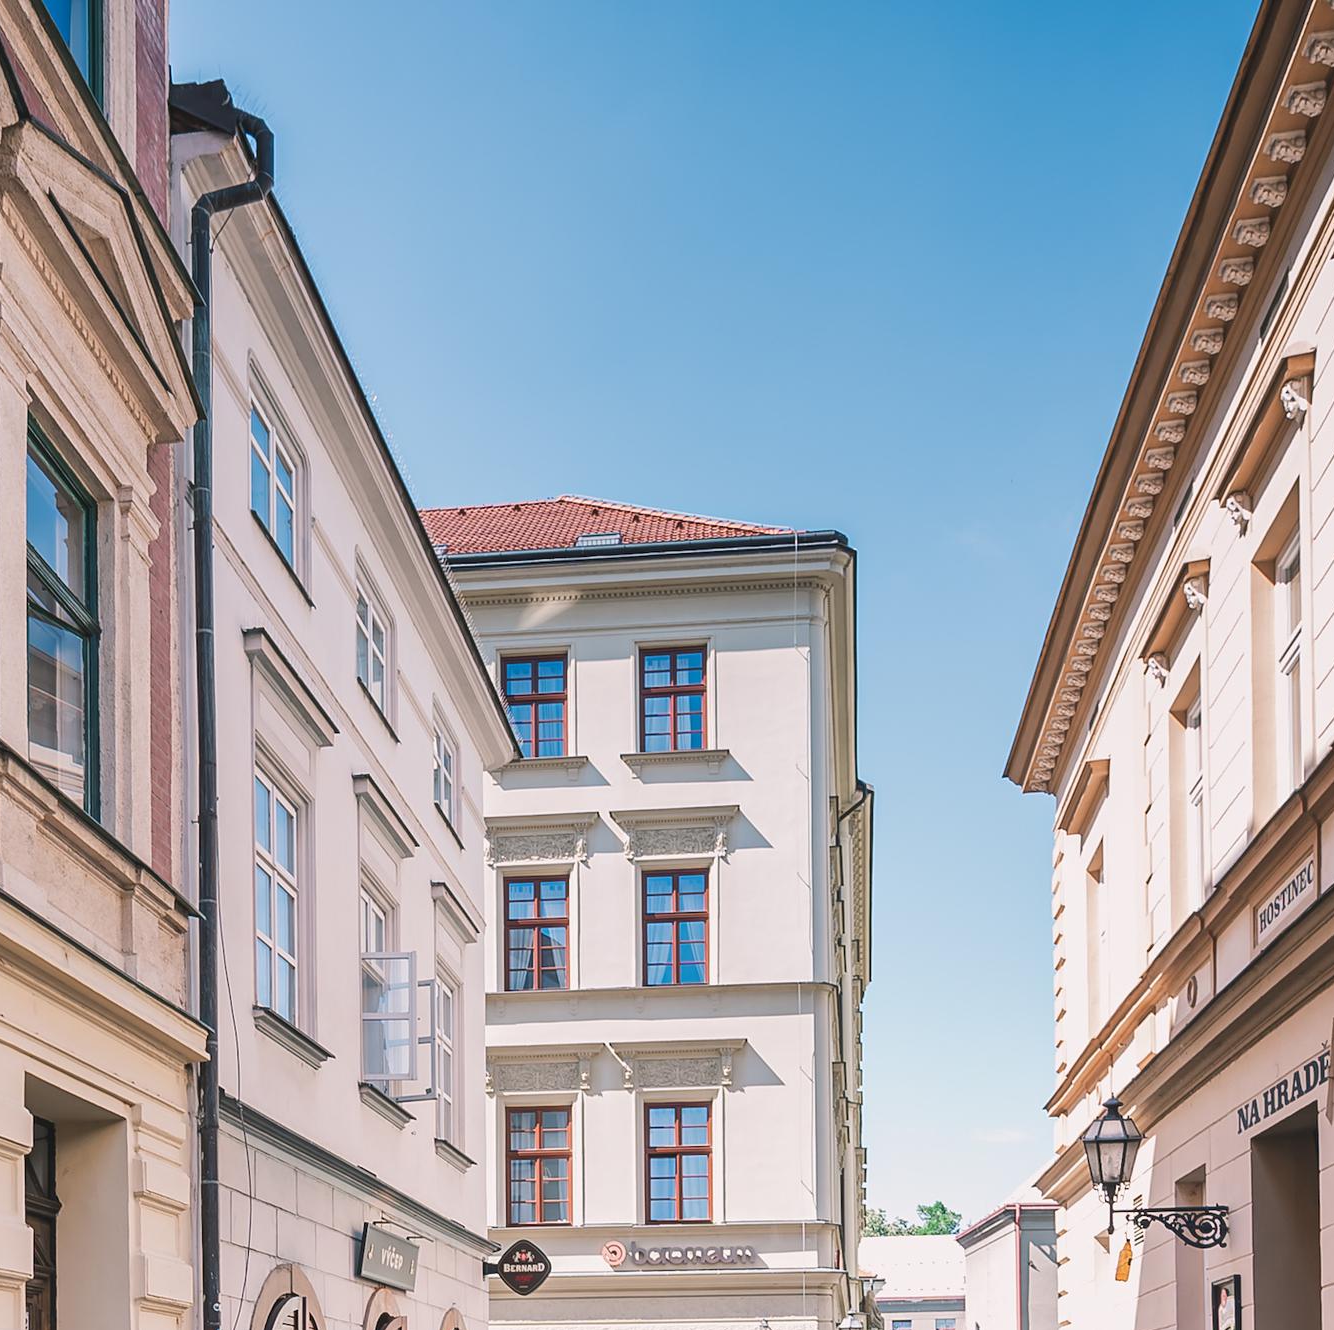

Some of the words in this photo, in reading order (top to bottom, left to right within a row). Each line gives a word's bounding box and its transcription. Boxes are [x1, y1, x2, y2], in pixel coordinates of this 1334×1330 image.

[1259, 860, 1314, 934] HOSTINEC
[1237, 1099, 1261, 1135] NA
[381, 1242, 404, 1273] VÝČEP
[503, 1263, 545, 1272] BERNARD
